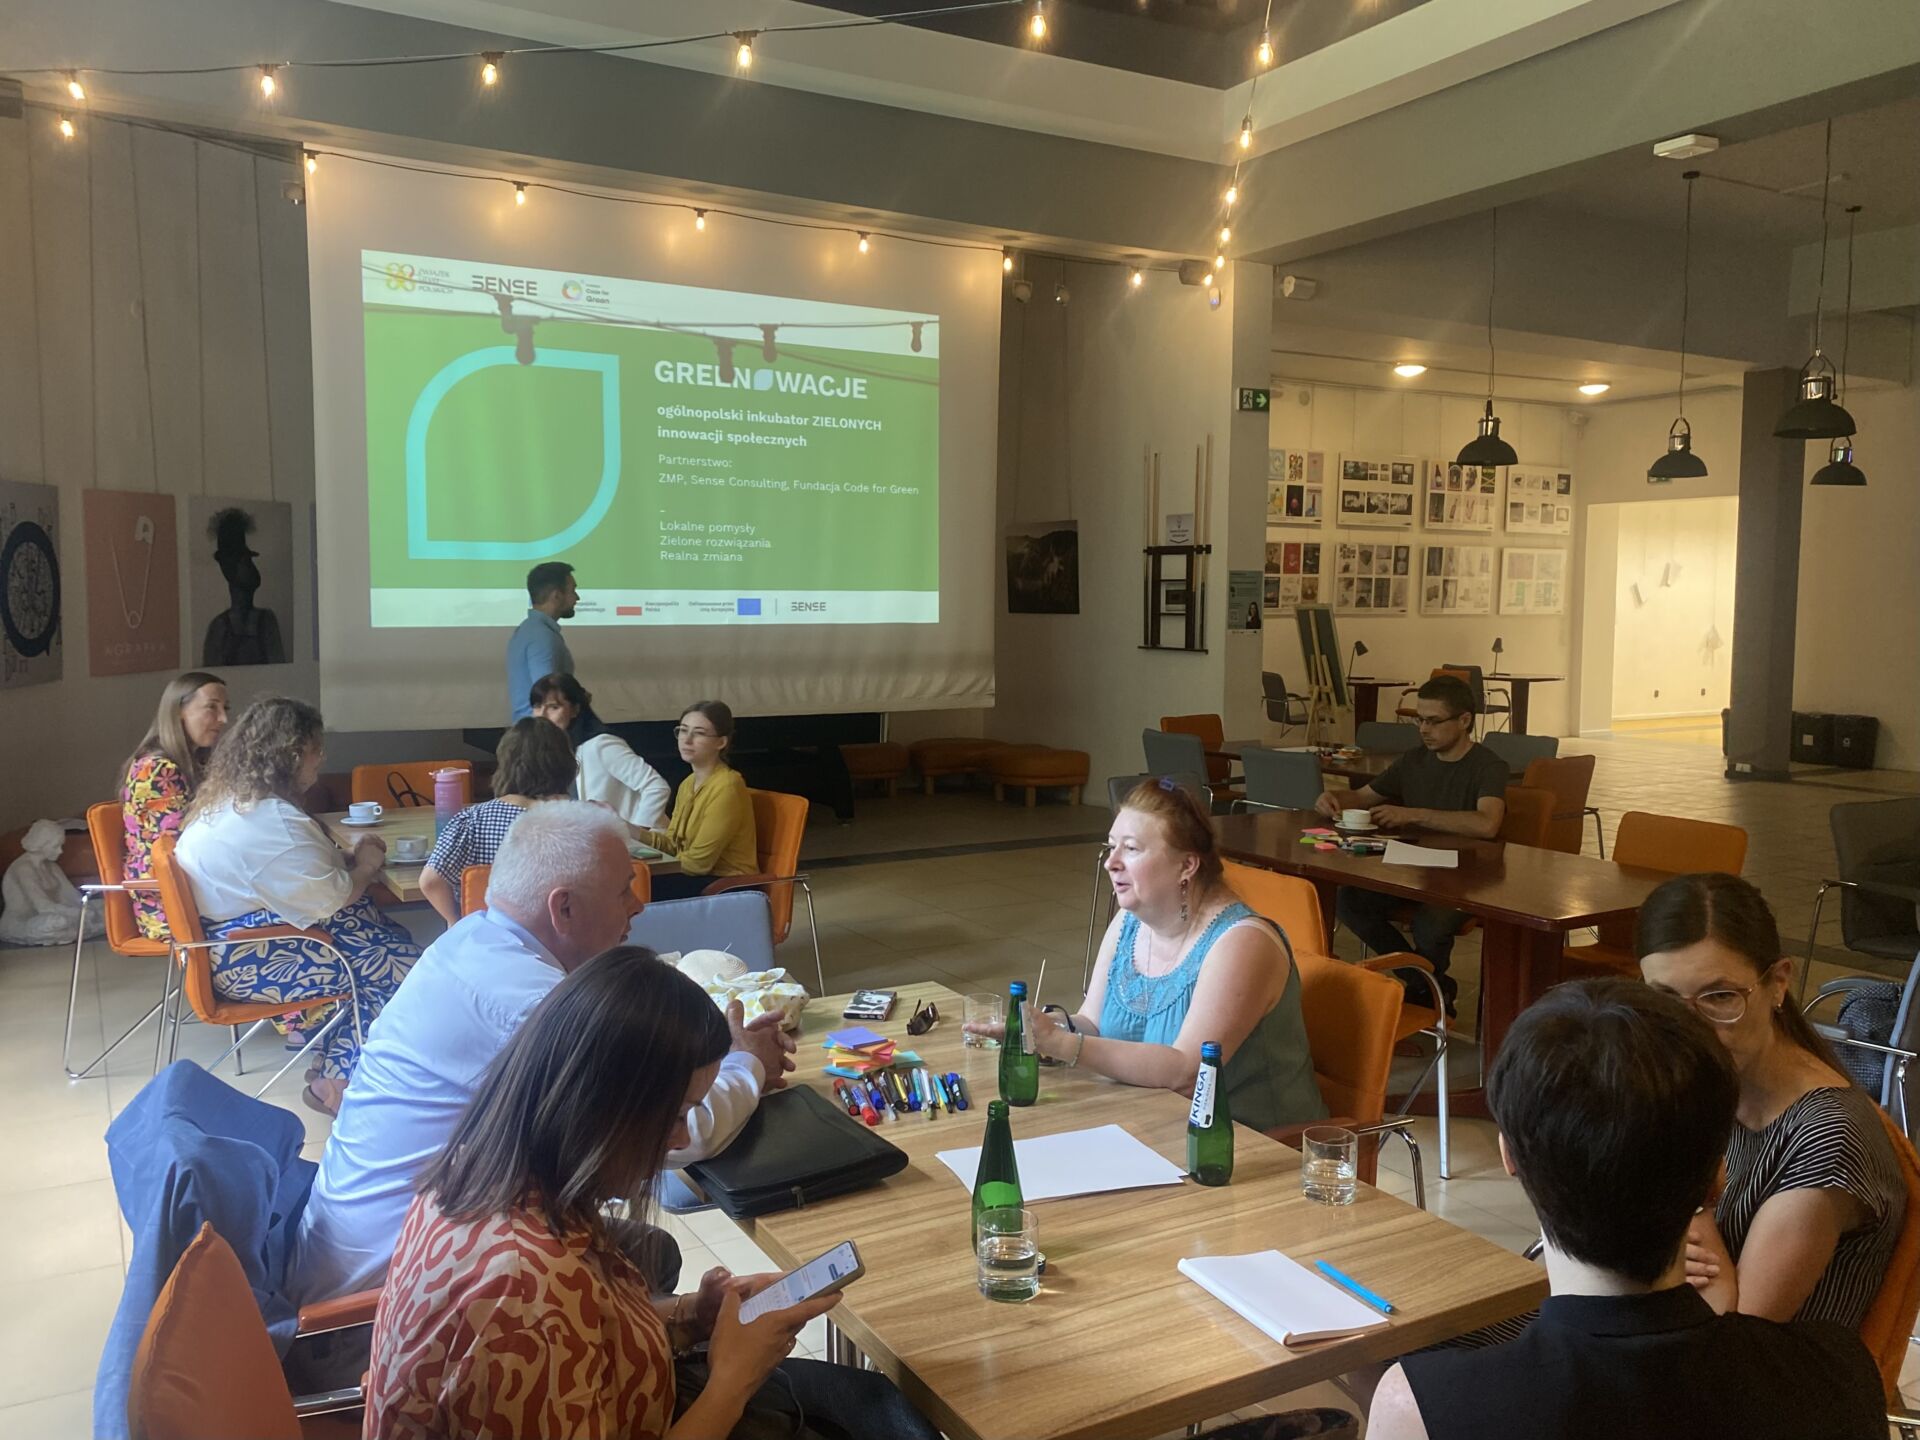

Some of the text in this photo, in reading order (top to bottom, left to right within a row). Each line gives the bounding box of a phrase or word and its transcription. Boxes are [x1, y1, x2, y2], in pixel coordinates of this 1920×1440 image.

[472, 274, 538, 297] SENSE
[586, 295, 610, 304] Green
[657, 405, 882, 431] ogólnopolski inkubator ZIELONYCH
[657, 426, 807, 448] innowacji społecznych
[658, 454, 733, 468] Partnerstwo:
[690, 475, 725, 486] Sense
[728, 476, 790, 491] Consulting,
[793, 479, 840, 494] Fundacja
[843, 482, 869, 493] Code
[872, 483, 886, 494] for
[889, 484, 919, 495] Green
[659, 521, 756, 535] Lokalne pomysły
[660, 535, 771, 549] Zielone rozwiązania
[660, 551, 743, 562] Realna zmiana
[791, 601, 827, 612] SENSE
[1191, 1070, 1207, 1119] KINGA
